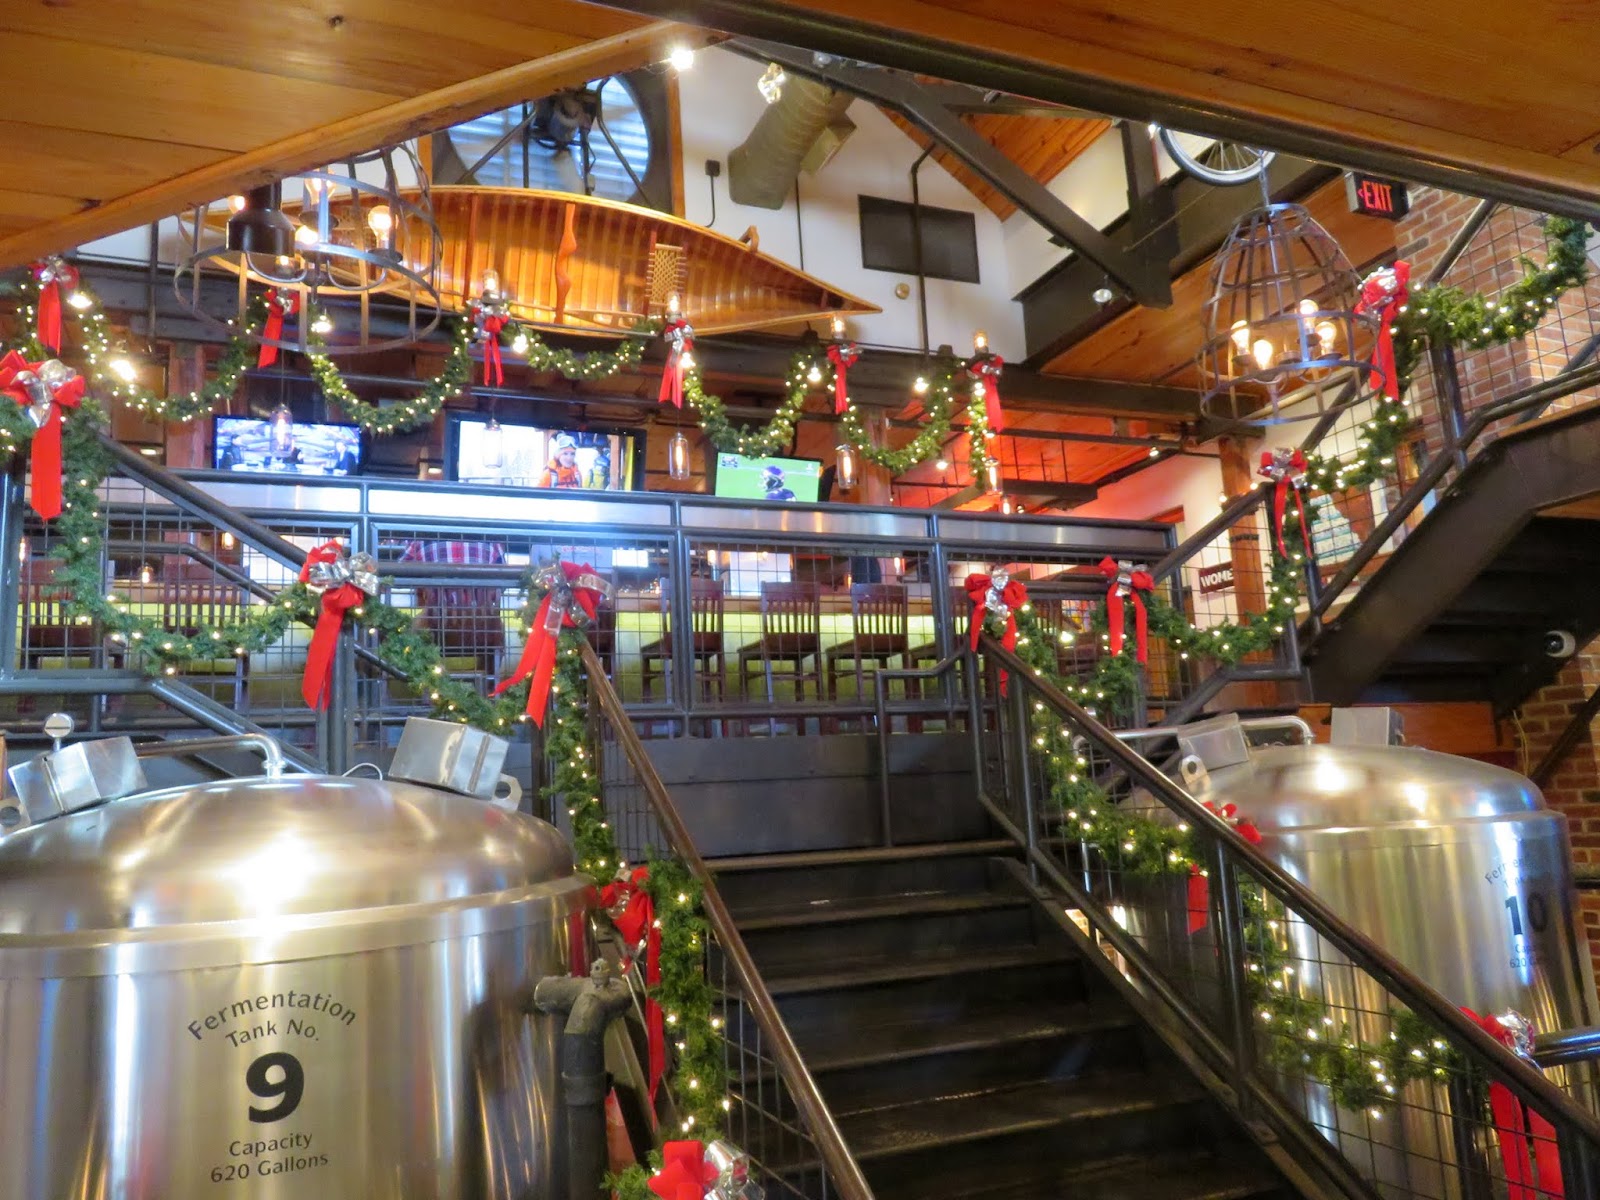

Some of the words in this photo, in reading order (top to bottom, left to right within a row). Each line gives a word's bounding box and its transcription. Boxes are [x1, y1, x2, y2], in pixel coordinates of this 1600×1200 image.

[1362, 180, 1393, 211] EXIT
[1200, 568, 1234, 587] WOME
[1505, 892, 1548, 935] 10
[188, 990, 357, 1041] Fermentation
[225, 1020, 277, 1048] Tank
[287, 1018, 320, 1042] No.
[246, 1051, 305, 1123] 9
[229, 1132, 313, 1157] Capacity
[211, 1163, 250, 1183] 620
[257, 1153, 329, 1176] Gallons
